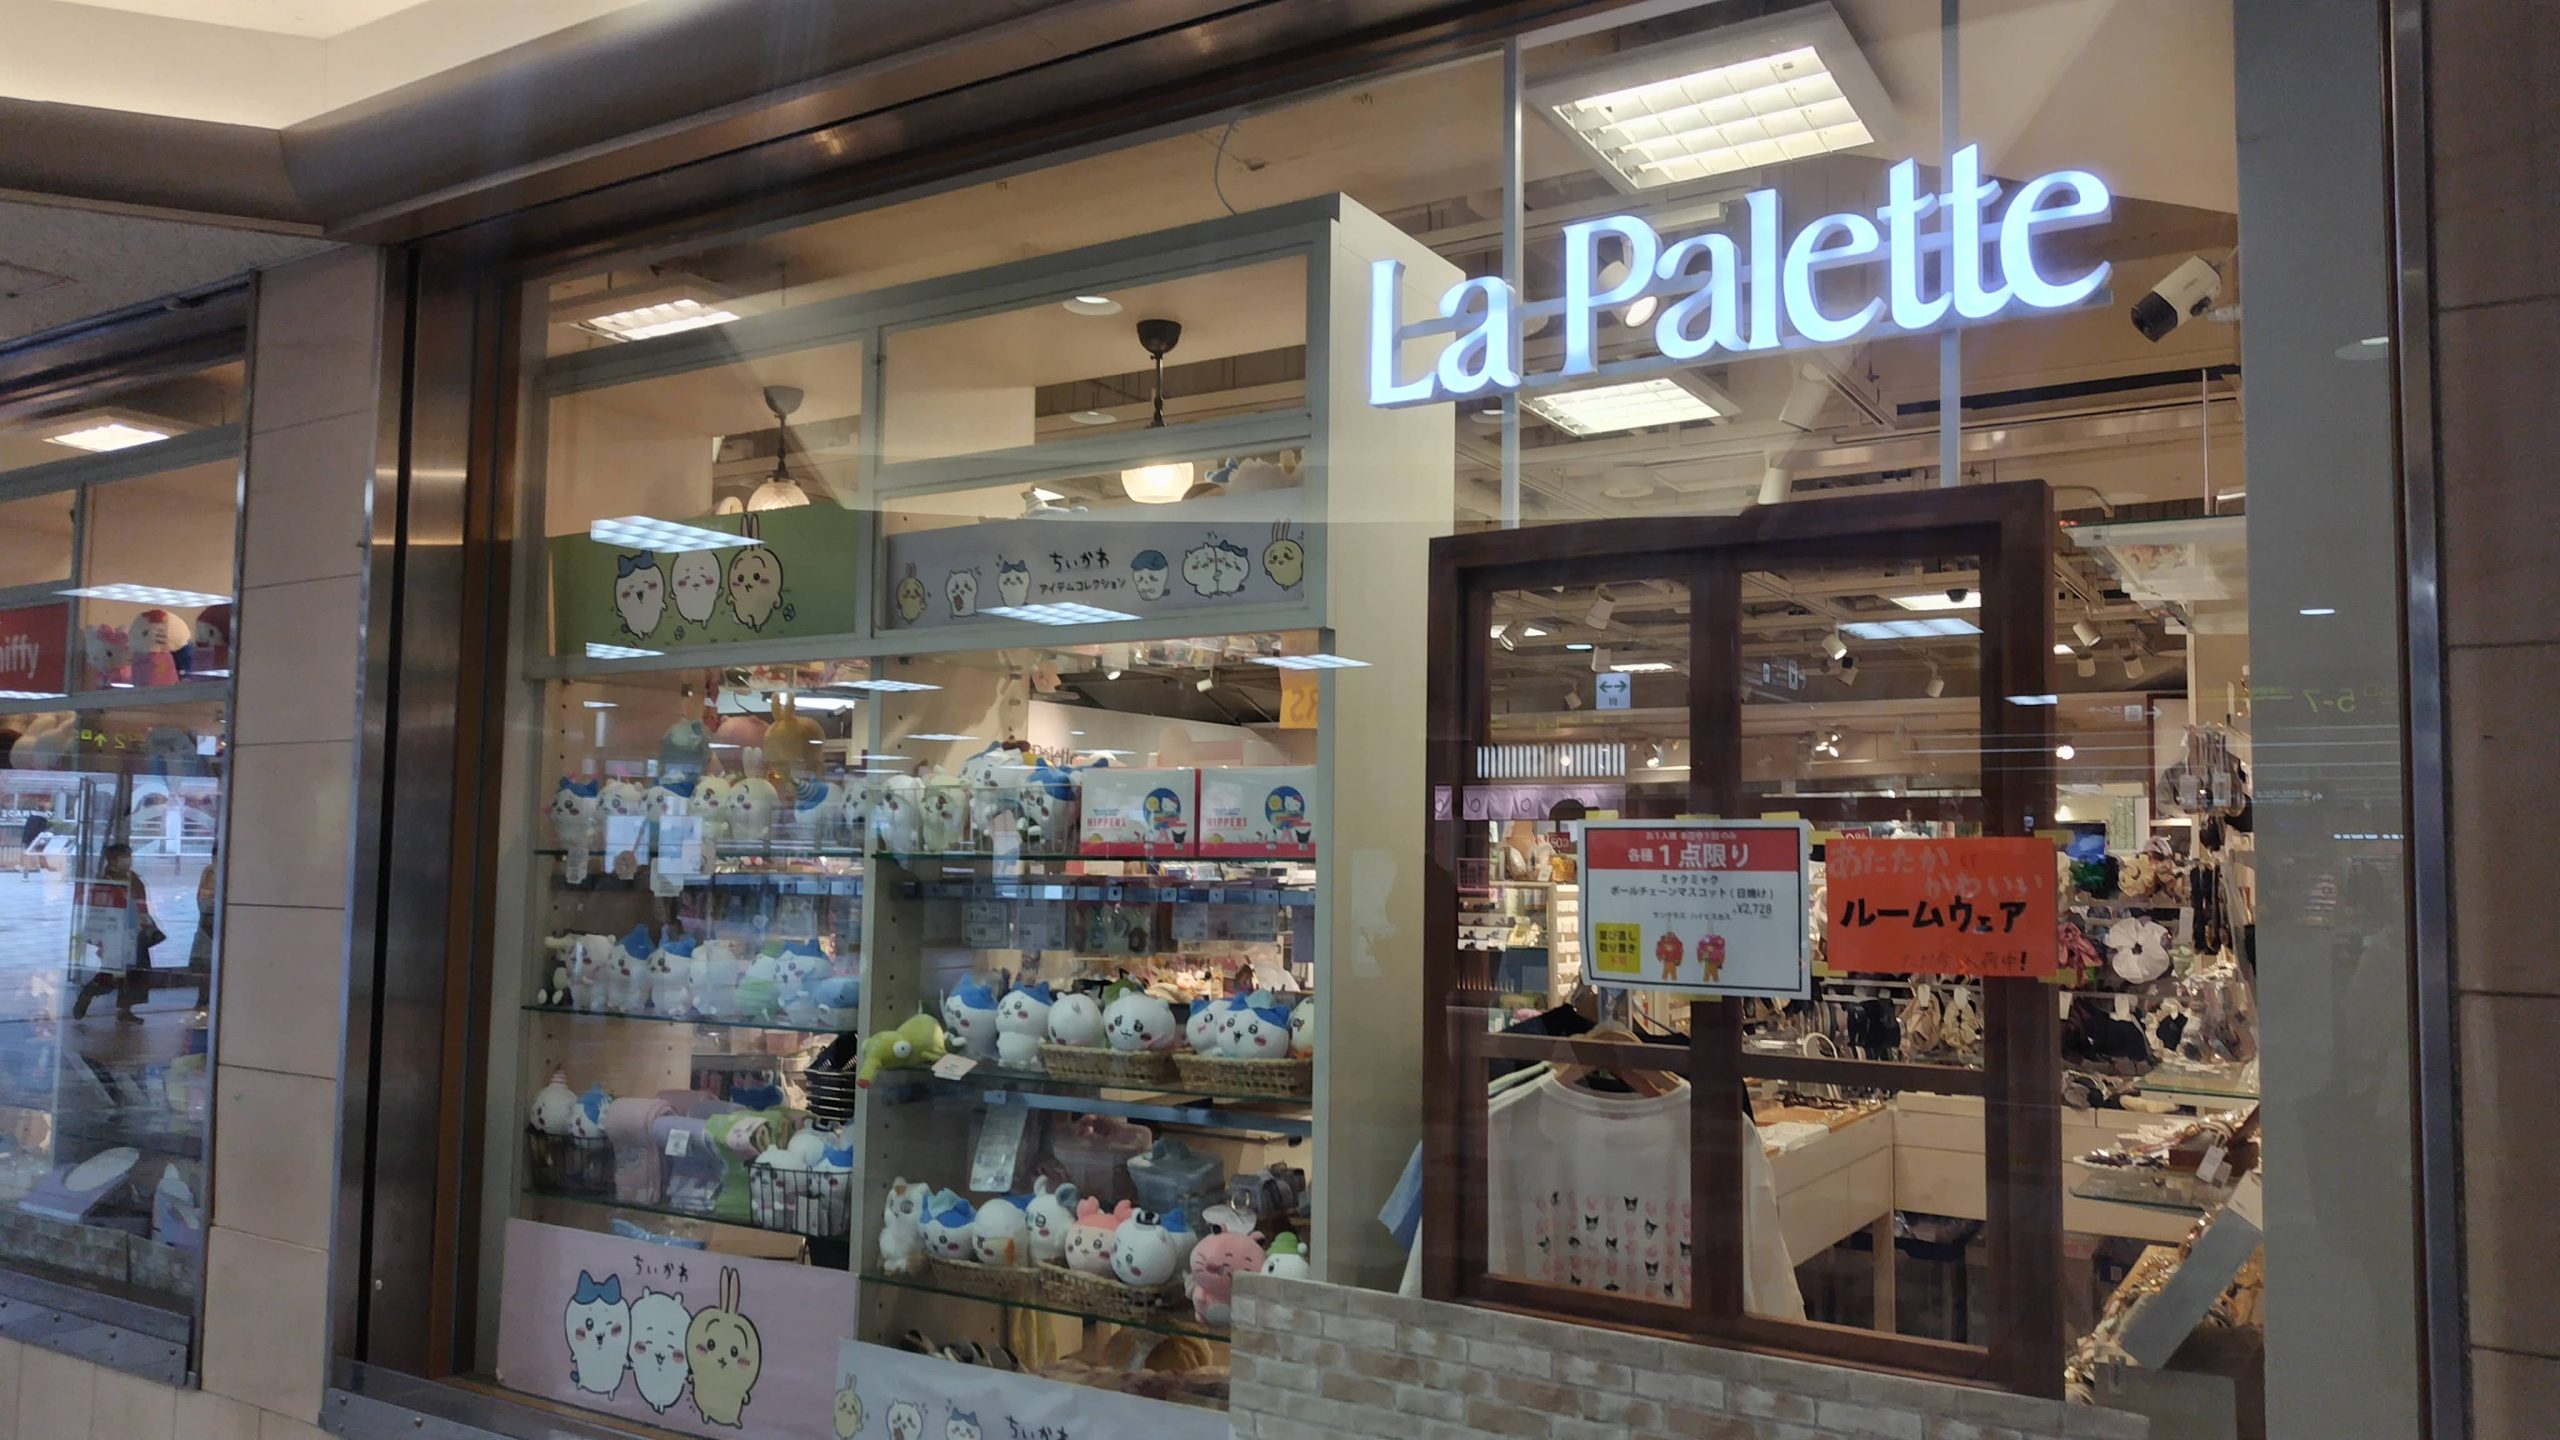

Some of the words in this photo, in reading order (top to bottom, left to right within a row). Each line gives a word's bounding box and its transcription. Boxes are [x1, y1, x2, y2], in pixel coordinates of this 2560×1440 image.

[1369, 259, 1522, 409] La
[1563, 143, 2114, 377] Palette
[1048, 547, 1110, 571] ちいかわ
[1040, 576, 1126, 595] アイテムコレクション
[0, 633, 40, 680] iffy
[1661, 873, 1719, 885] ミャクミャク
[1925, 871, 2043, 900] かわいい
[1839, 895, 2027, 935] ルームウェア
[633, 1254, 690, 1284] ちいかわ
